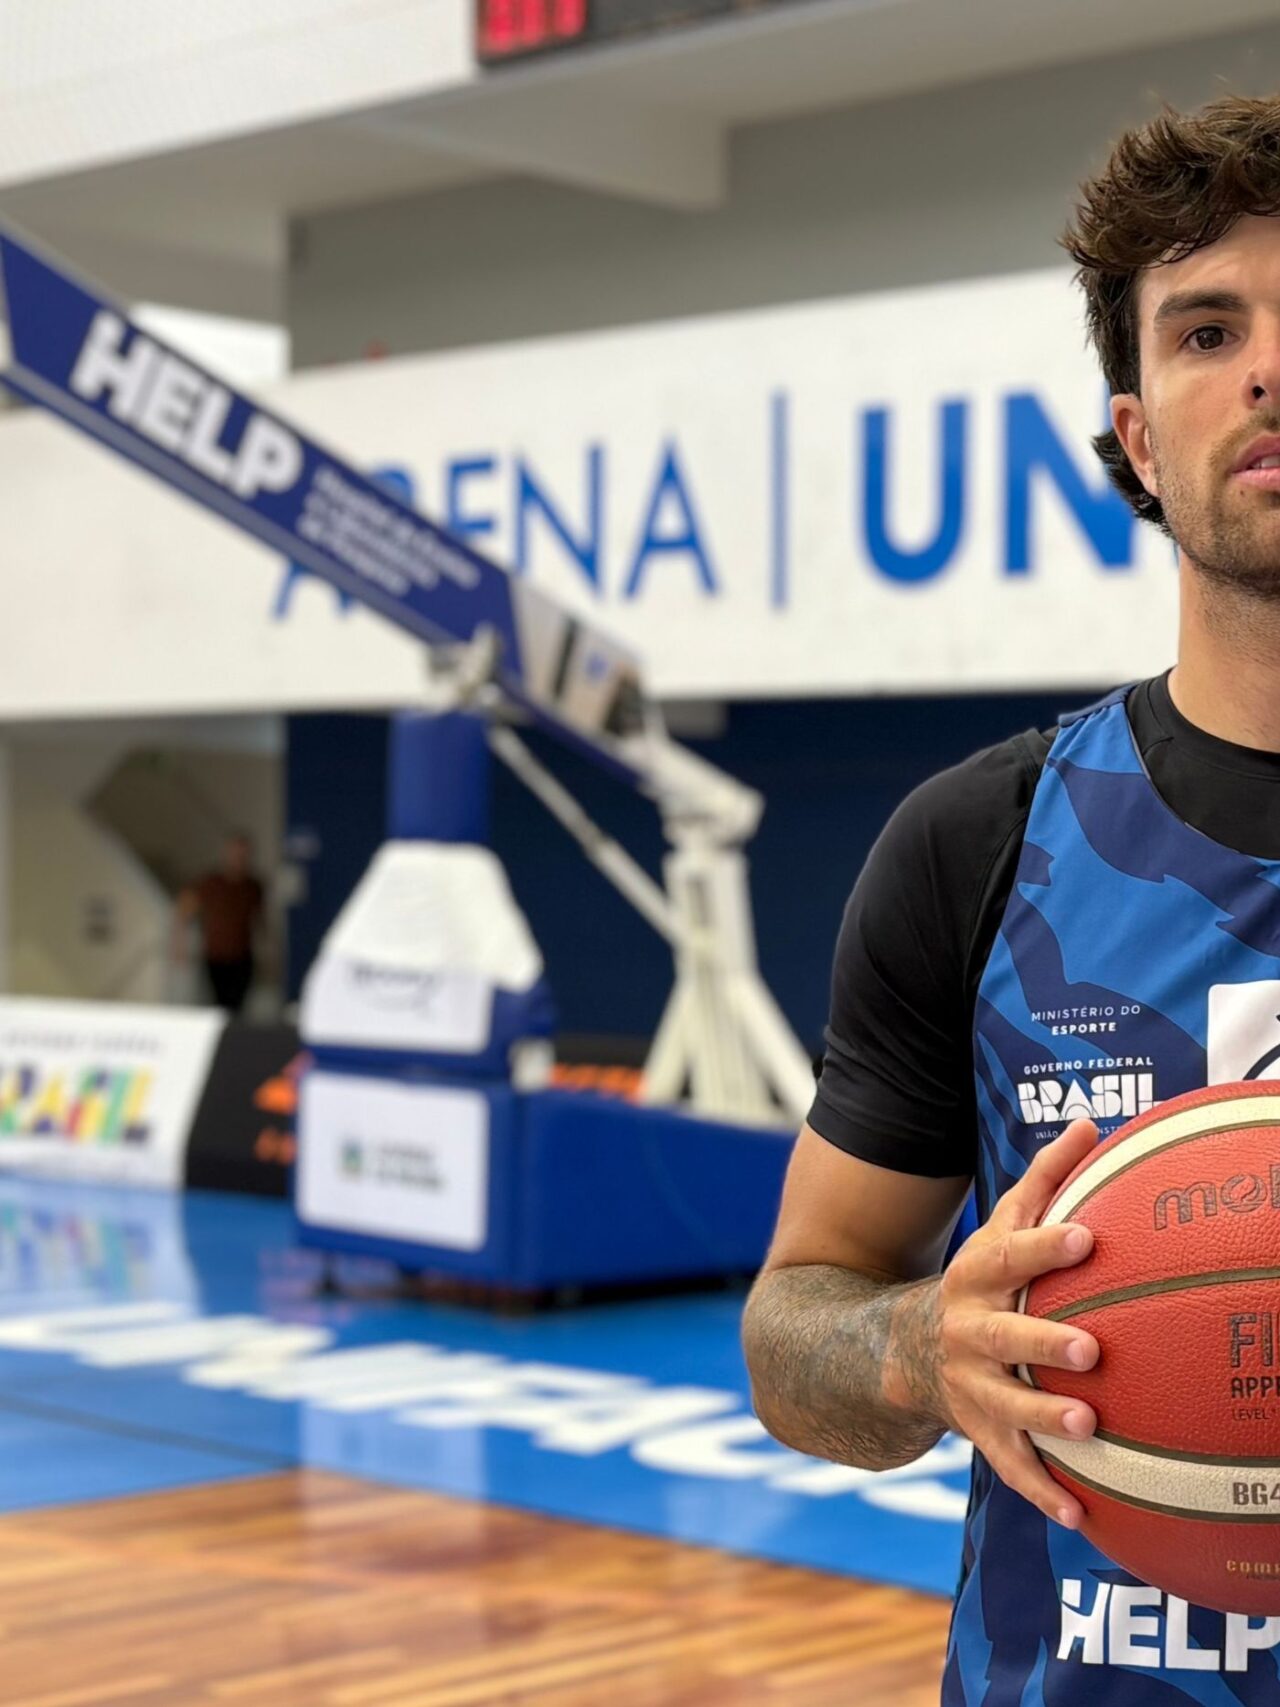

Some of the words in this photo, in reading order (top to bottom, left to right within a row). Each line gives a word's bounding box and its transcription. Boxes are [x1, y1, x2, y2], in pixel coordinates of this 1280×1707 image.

[70, 306, 303, 499] HELP
[1031, 1006, 1114, 1021] MINISTÉRIO
[1121, 1005, 1141, 1016] DO
[1051, 1022, 1117, 1035] ESPORTE
[1024, 1060, 1083, 1075] GOVERNO
[1088, 1056, 1154, 1070] FEDERAL
[1017, 1073, 1162, 1124] BRASIL
[1232, 1407, 1270, 1421] LEVEL
